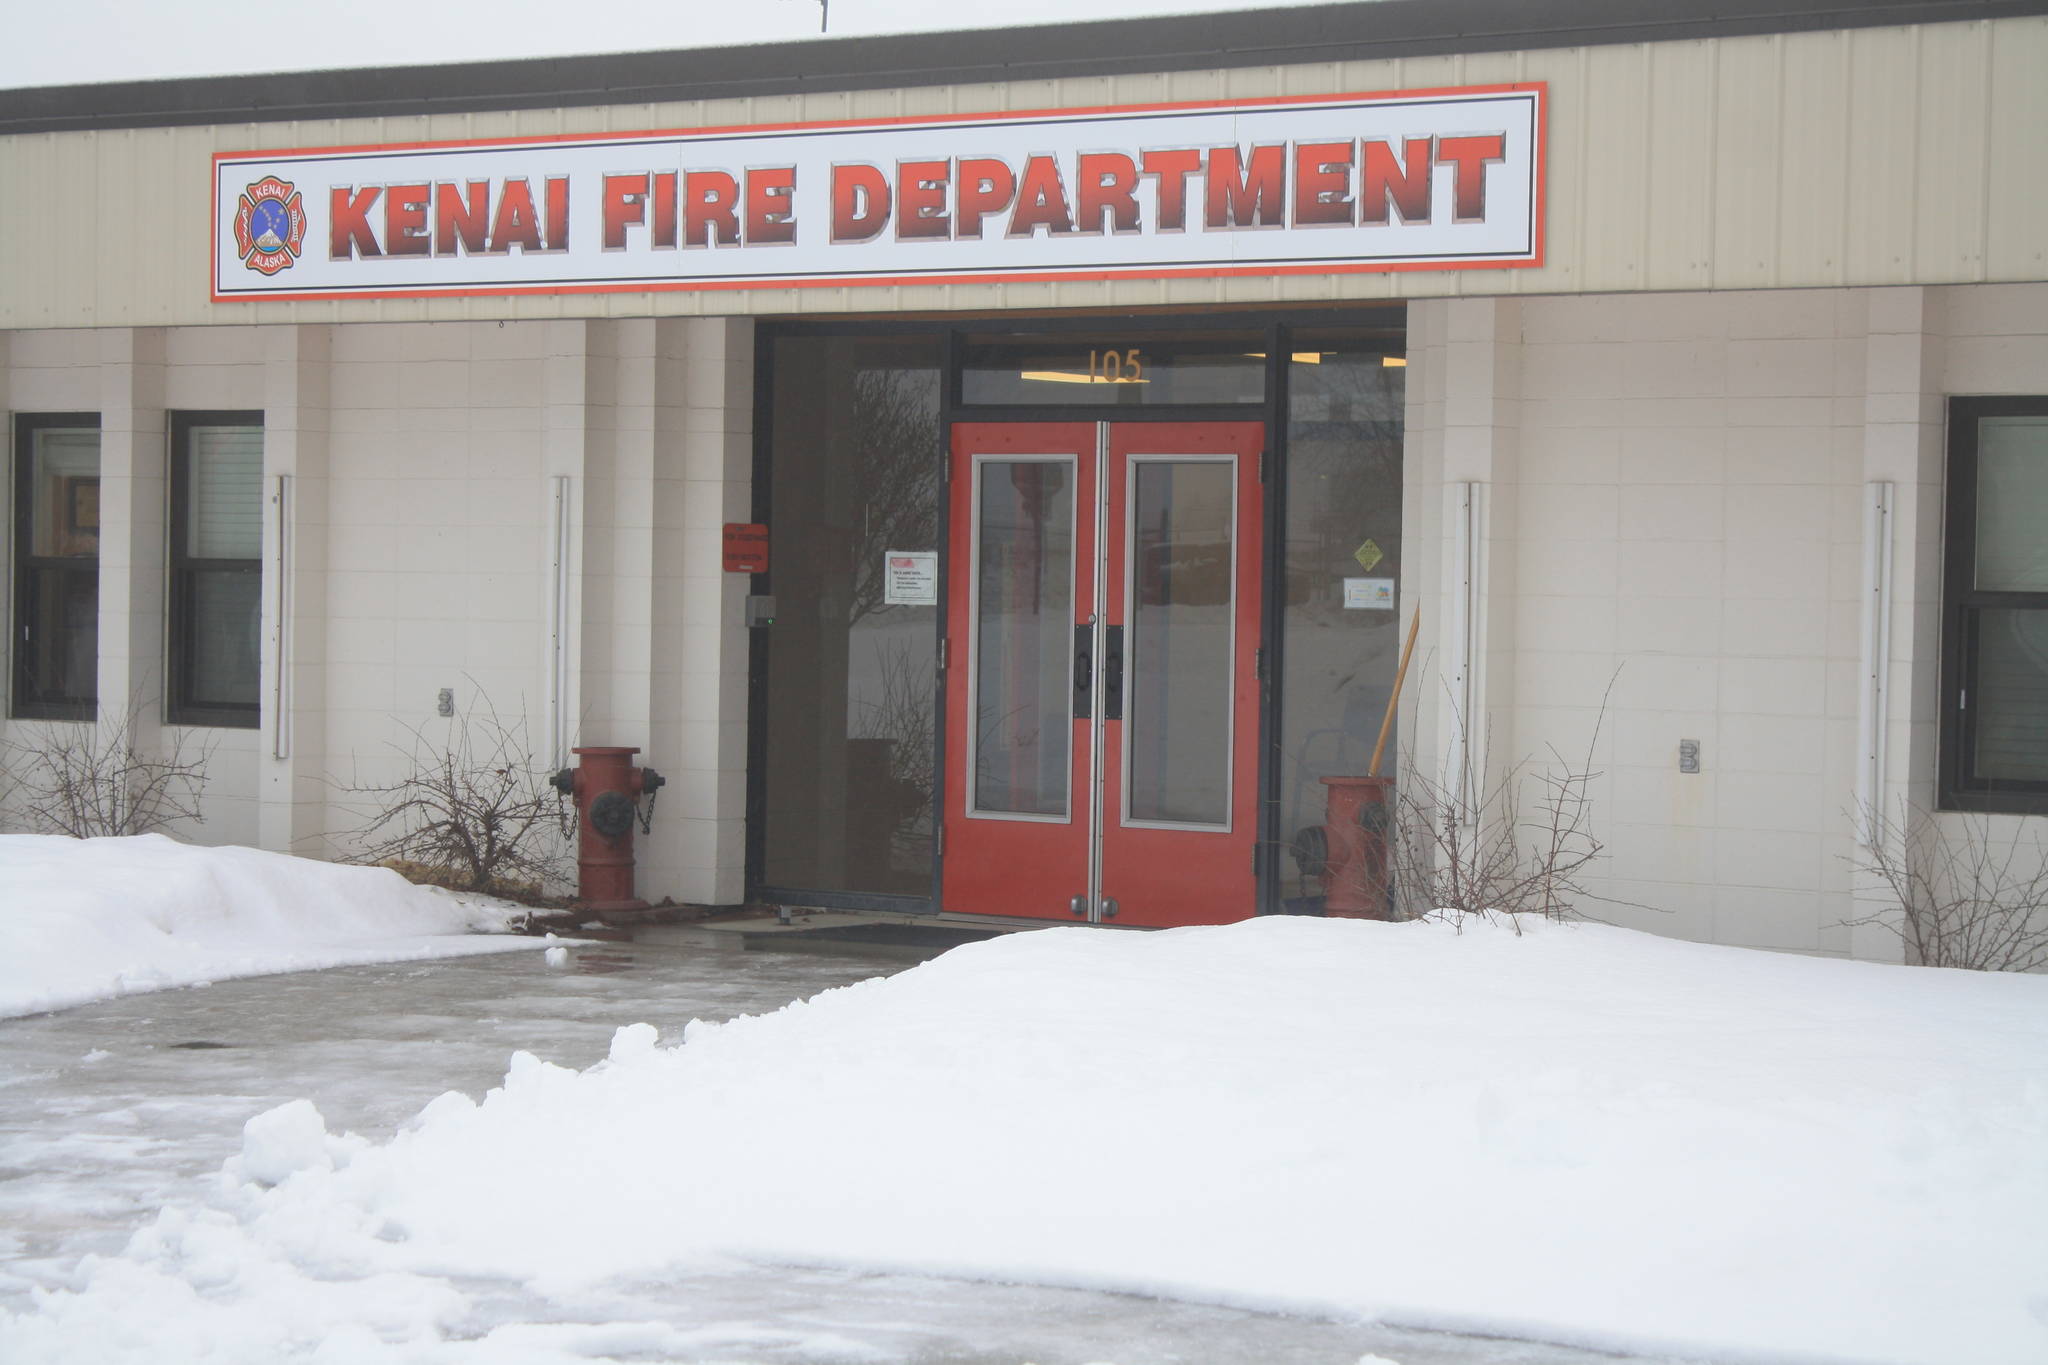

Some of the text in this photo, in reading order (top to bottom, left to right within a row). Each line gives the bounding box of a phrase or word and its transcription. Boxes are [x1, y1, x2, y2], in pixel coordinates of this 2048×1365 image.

[256, 184, 285, 199] KENAI
[329, 129, 1507, 262] KENAI FIRE DEPARTMENT
[254, 253, 286, 268] ALASKA
[1089, 349, 1142, 383] 105
